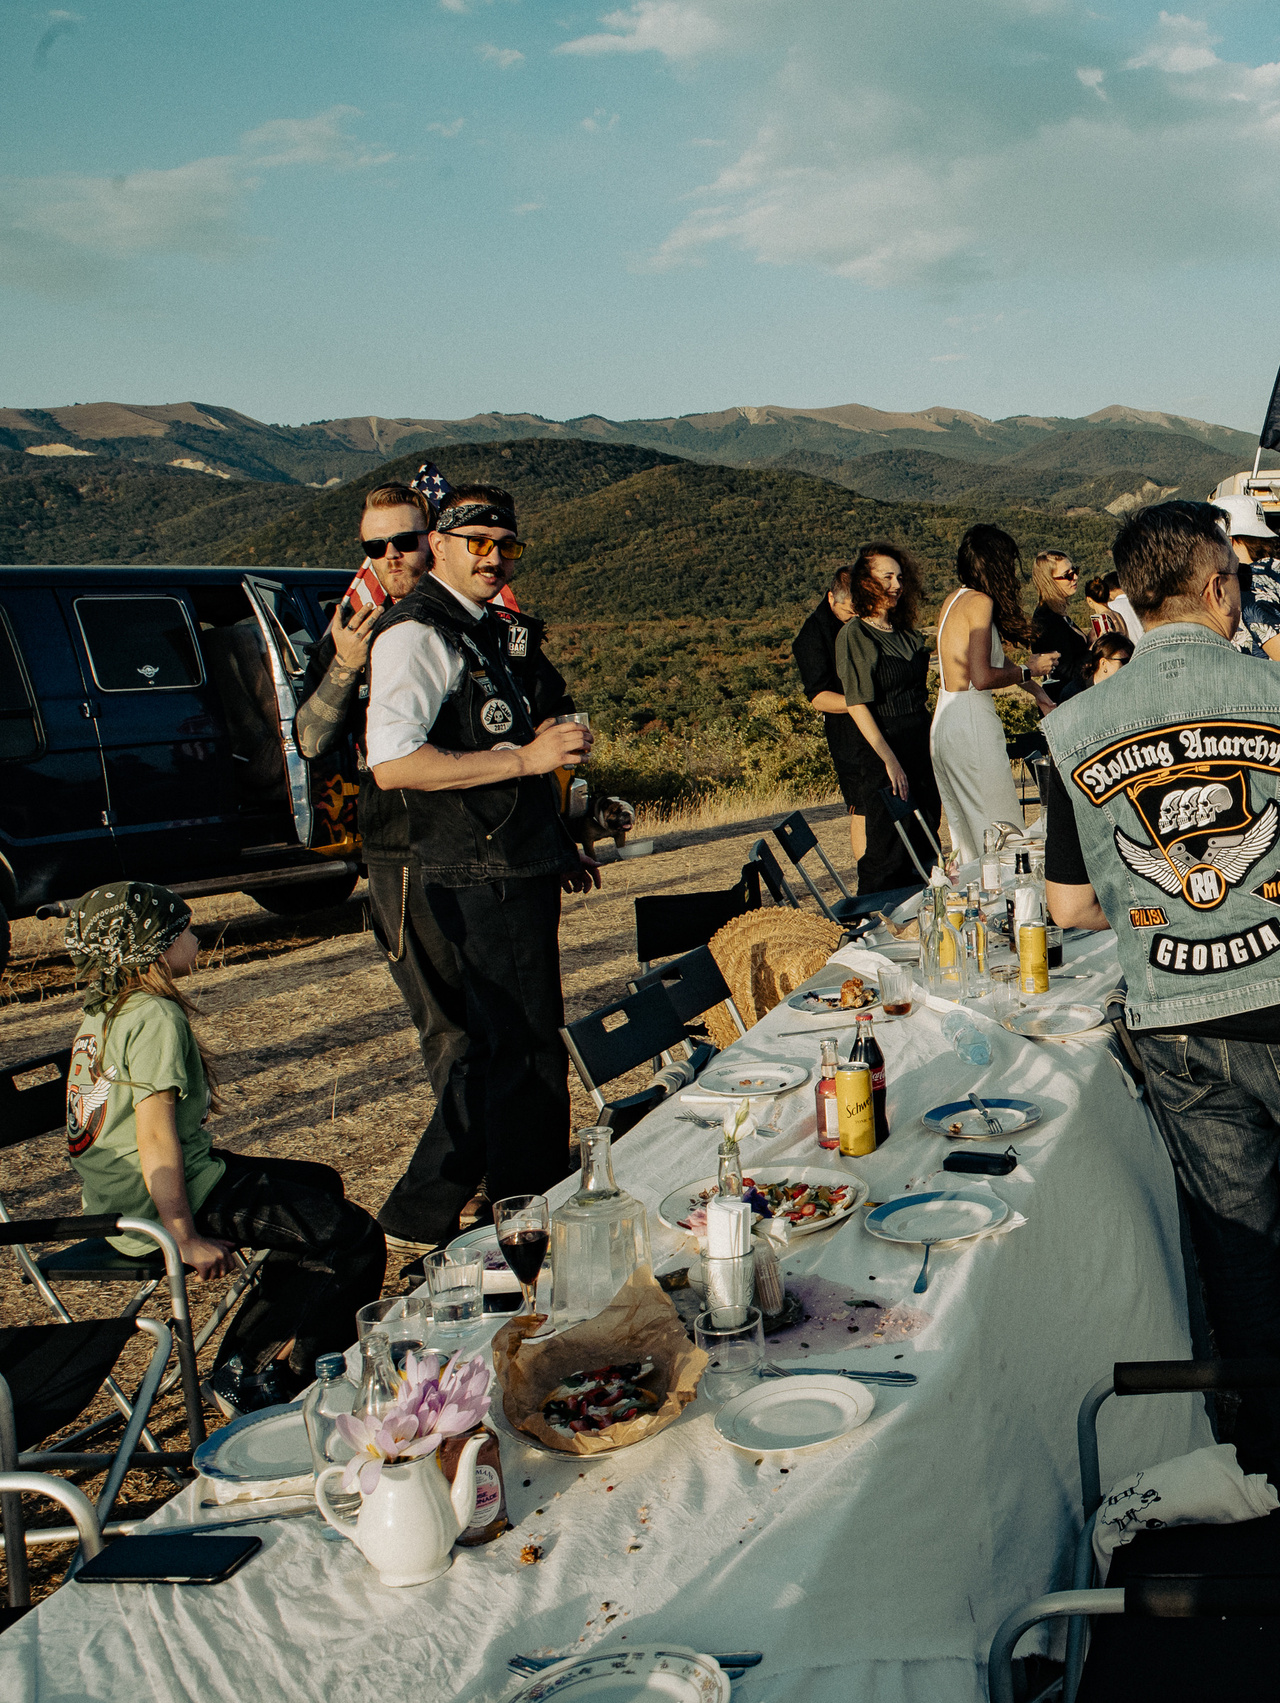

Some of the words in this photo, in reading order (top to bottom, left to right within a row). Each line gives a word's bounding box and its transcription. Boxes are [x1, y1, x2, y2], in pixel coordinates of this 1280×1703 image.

[509, 643, 525, 651] BAR
[484, 704, 495, 722] GYPSY
[1082, 741, 1174, 794] Rolling
[1189, 870, 1219, 903] RA
[1131, 909, 1165, 927] TBILISI
[1156, 924, 1280, 971] GEORGIA
